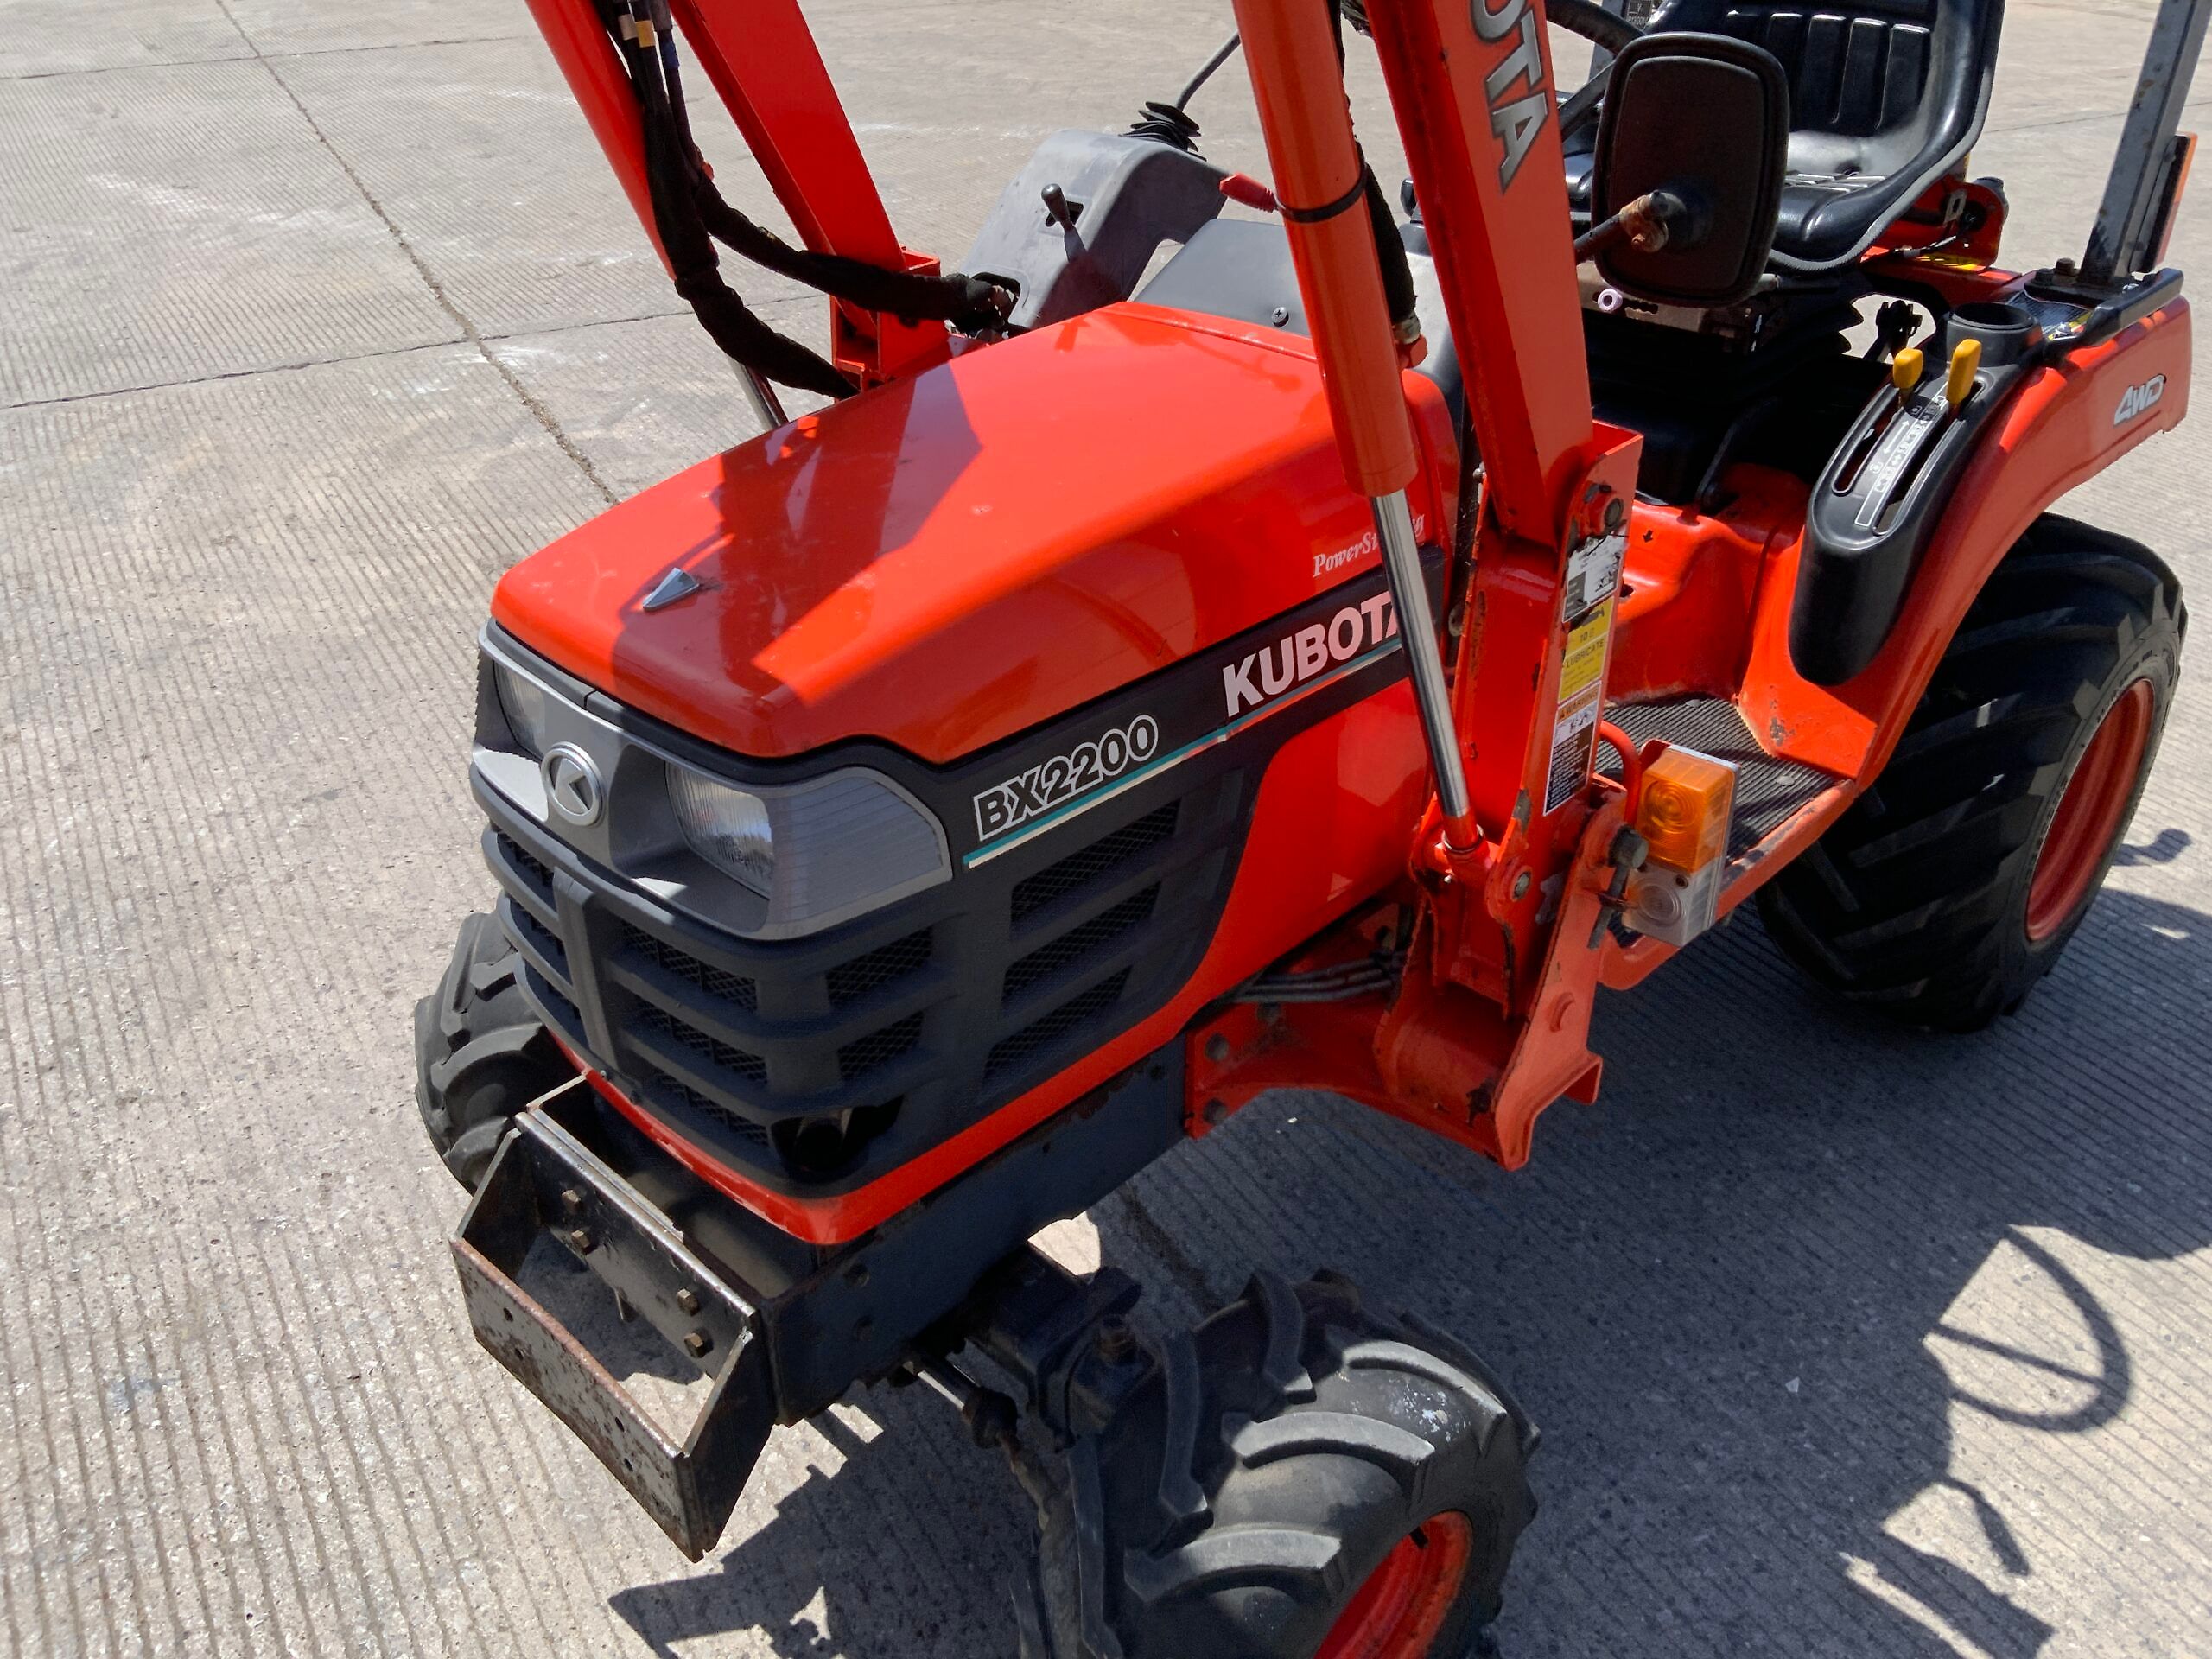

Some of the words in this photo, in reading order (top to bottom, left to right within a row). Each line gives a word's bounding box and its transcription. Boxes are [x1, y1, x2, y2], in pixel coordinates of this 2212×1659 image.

[2113, 374, 2166, 426] 4WD
[1313, 513, 1425, 578] PowerStg
[1566, 639, 1605, 668] LUBRICATE
[973, 714, 1159, 841] BX2200
